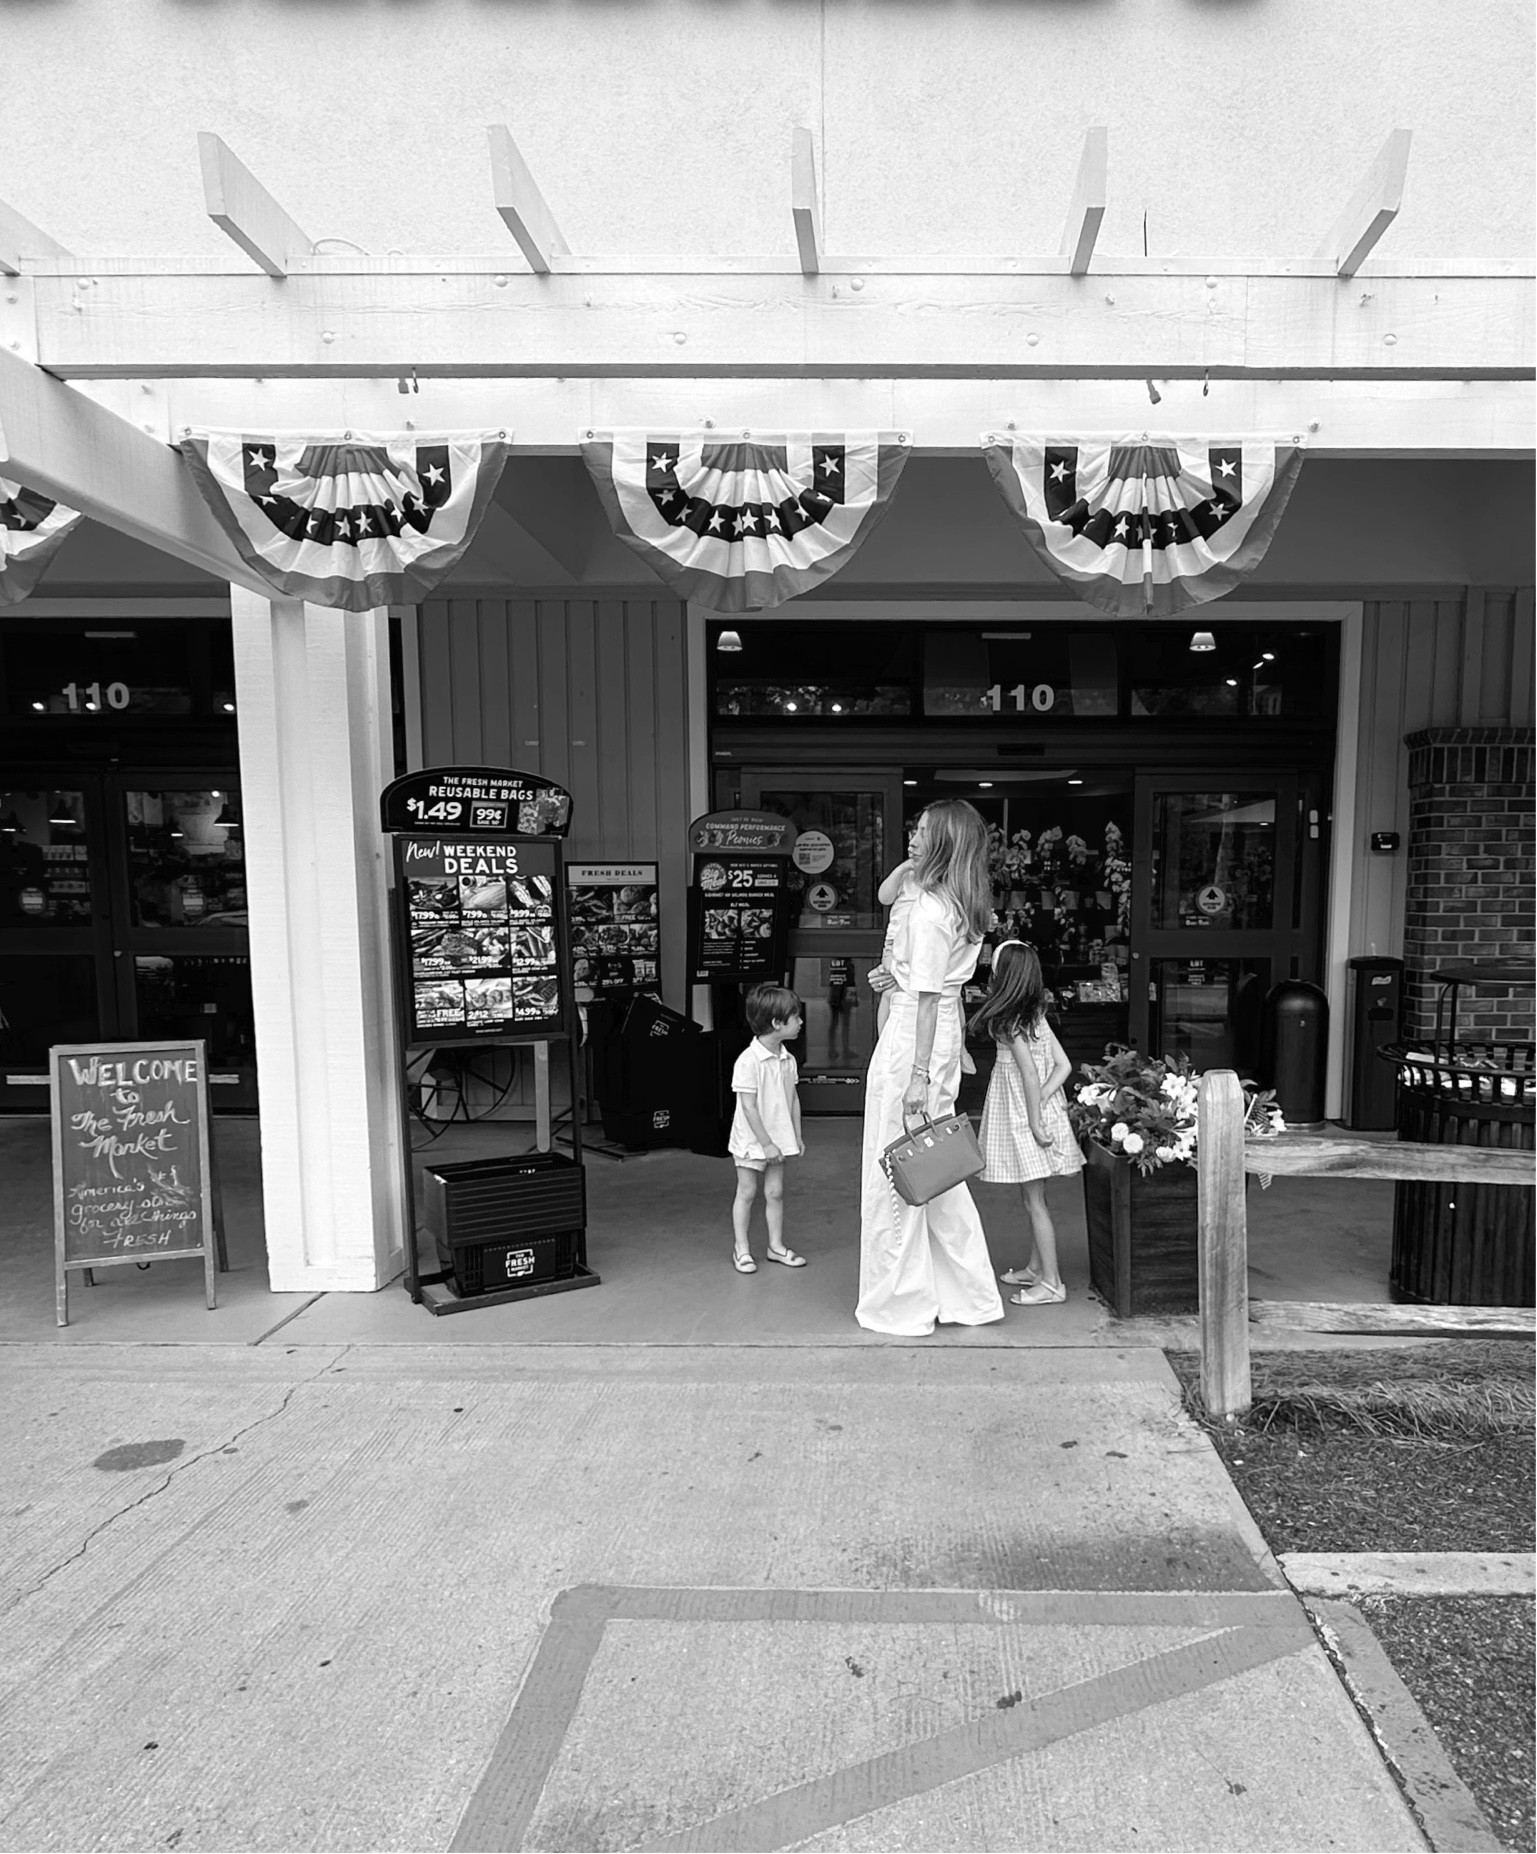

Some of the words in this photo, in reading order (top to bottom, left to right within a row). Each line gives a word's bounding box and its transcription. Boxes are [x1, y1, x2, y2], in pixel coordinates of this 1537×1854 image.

[62, 682, 130, 709] 110
[987, 684, 1054, 711] 110
[443, 776, 459, 786] THE
[462, 777, 488, 787] FRESH
[490, 779, 523, 788] MARKET
[429, 785, 498, 799] REUSABLE
[501, 789, 533, 800] BAGS
[406, 797, 462, 820] $1.49
[476, 808, 502, 820] 99¢
[706, 822, 739, 830] COMMAND
[740, 823, 785, 832] PERFORMANCE
[726, 830, 763, 845] Peonies
[406, 840, 440, 863] New!
[443, 845, 517, 857] WEEKEND
[444, 858, 519, 874] DEALS
[728, 869, 753, 888] $25
[67, 1056, 197, 1086] WELCOME
[109, 1088, 140, 1105] to
[71, 1111, 112, 1137] The
[112, 1100, 190, 1131] Fresh
[78, 1128, 178, 1180] Market
[68, 1178, 144, 1200] America's
[70, 1200, 134, 1225] grocery
[103, 1228, 171, 1248] FRESH
[505, 1256, 535, 1268] FRESH
